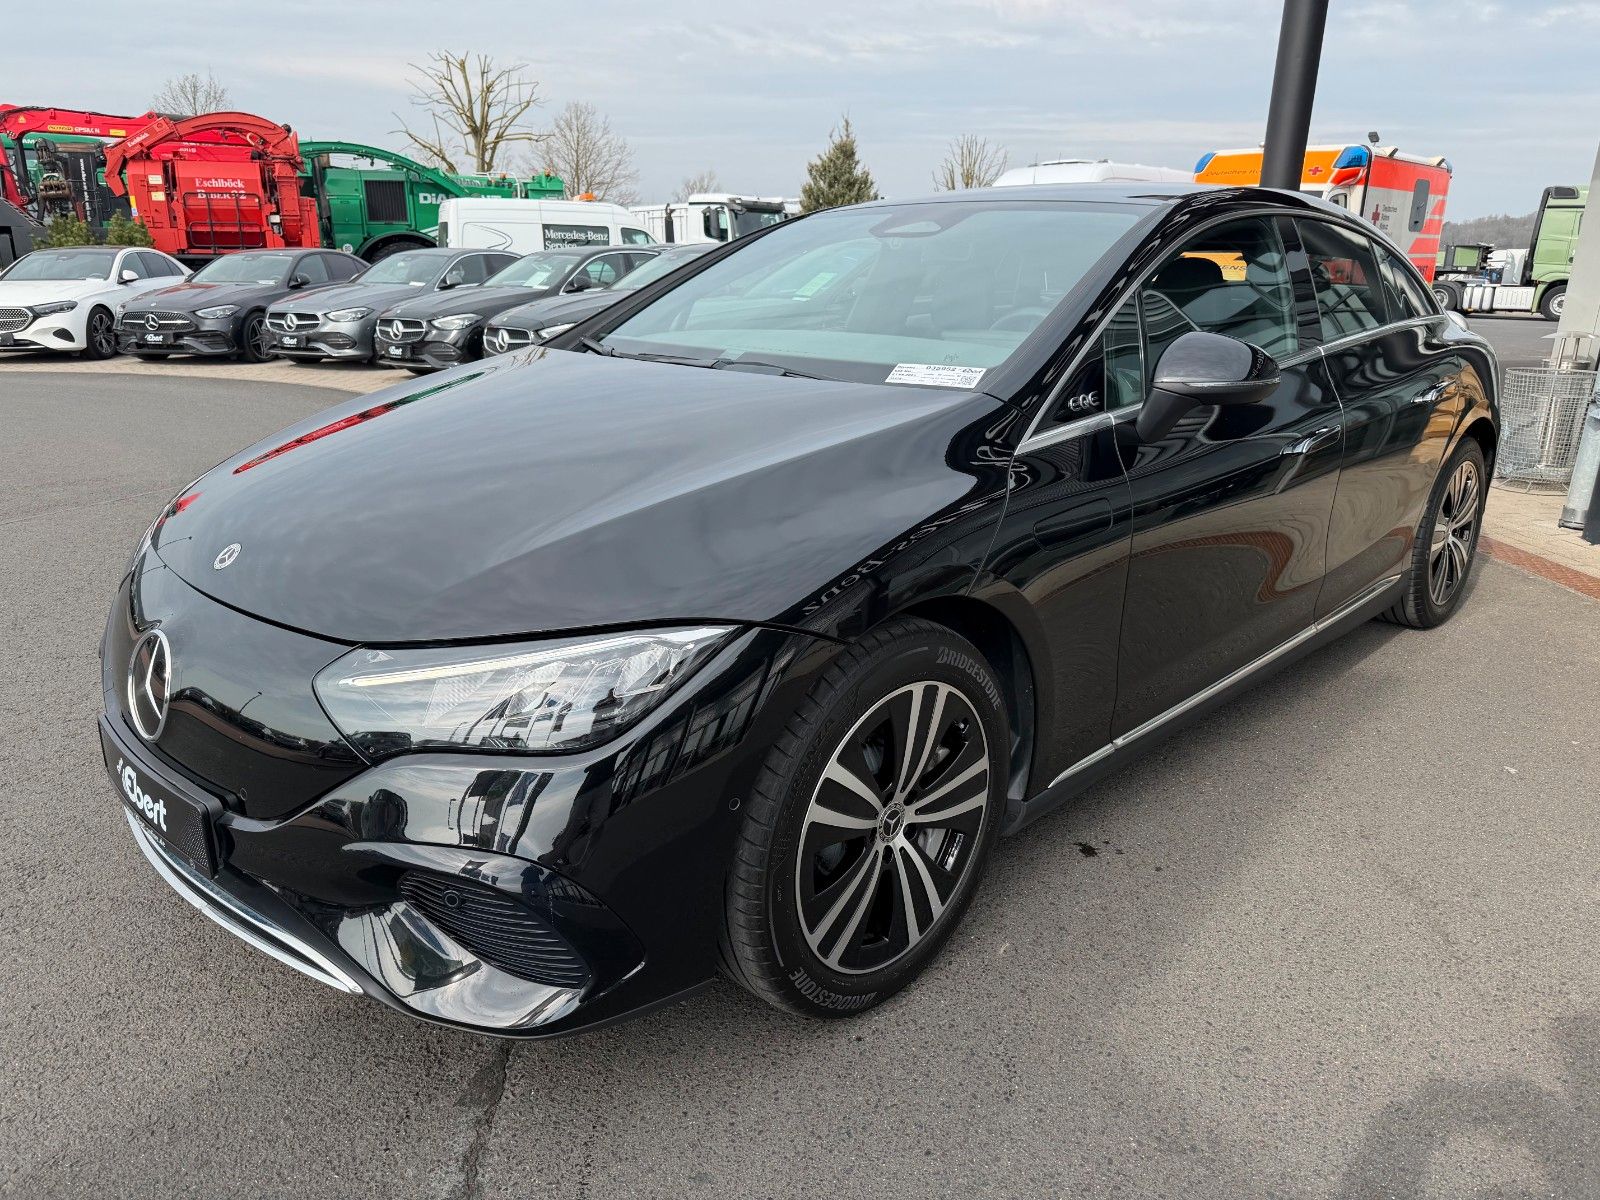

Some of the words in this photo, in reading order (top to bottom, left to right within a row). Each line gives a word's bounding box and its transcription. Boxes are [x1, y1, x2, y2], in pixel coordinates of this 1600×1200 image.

[195, 178, 245, 188] Eschlböck
[544, 229, 609, 241] Mercedes-Benz
[1067, 390, 1100, 412] EQE
[936, 646, 1002, 711] BRIDGESTONE
[120, 764, 167, 833] Ebert
[788, 966, 878, 1010] BRIDGESTONE
